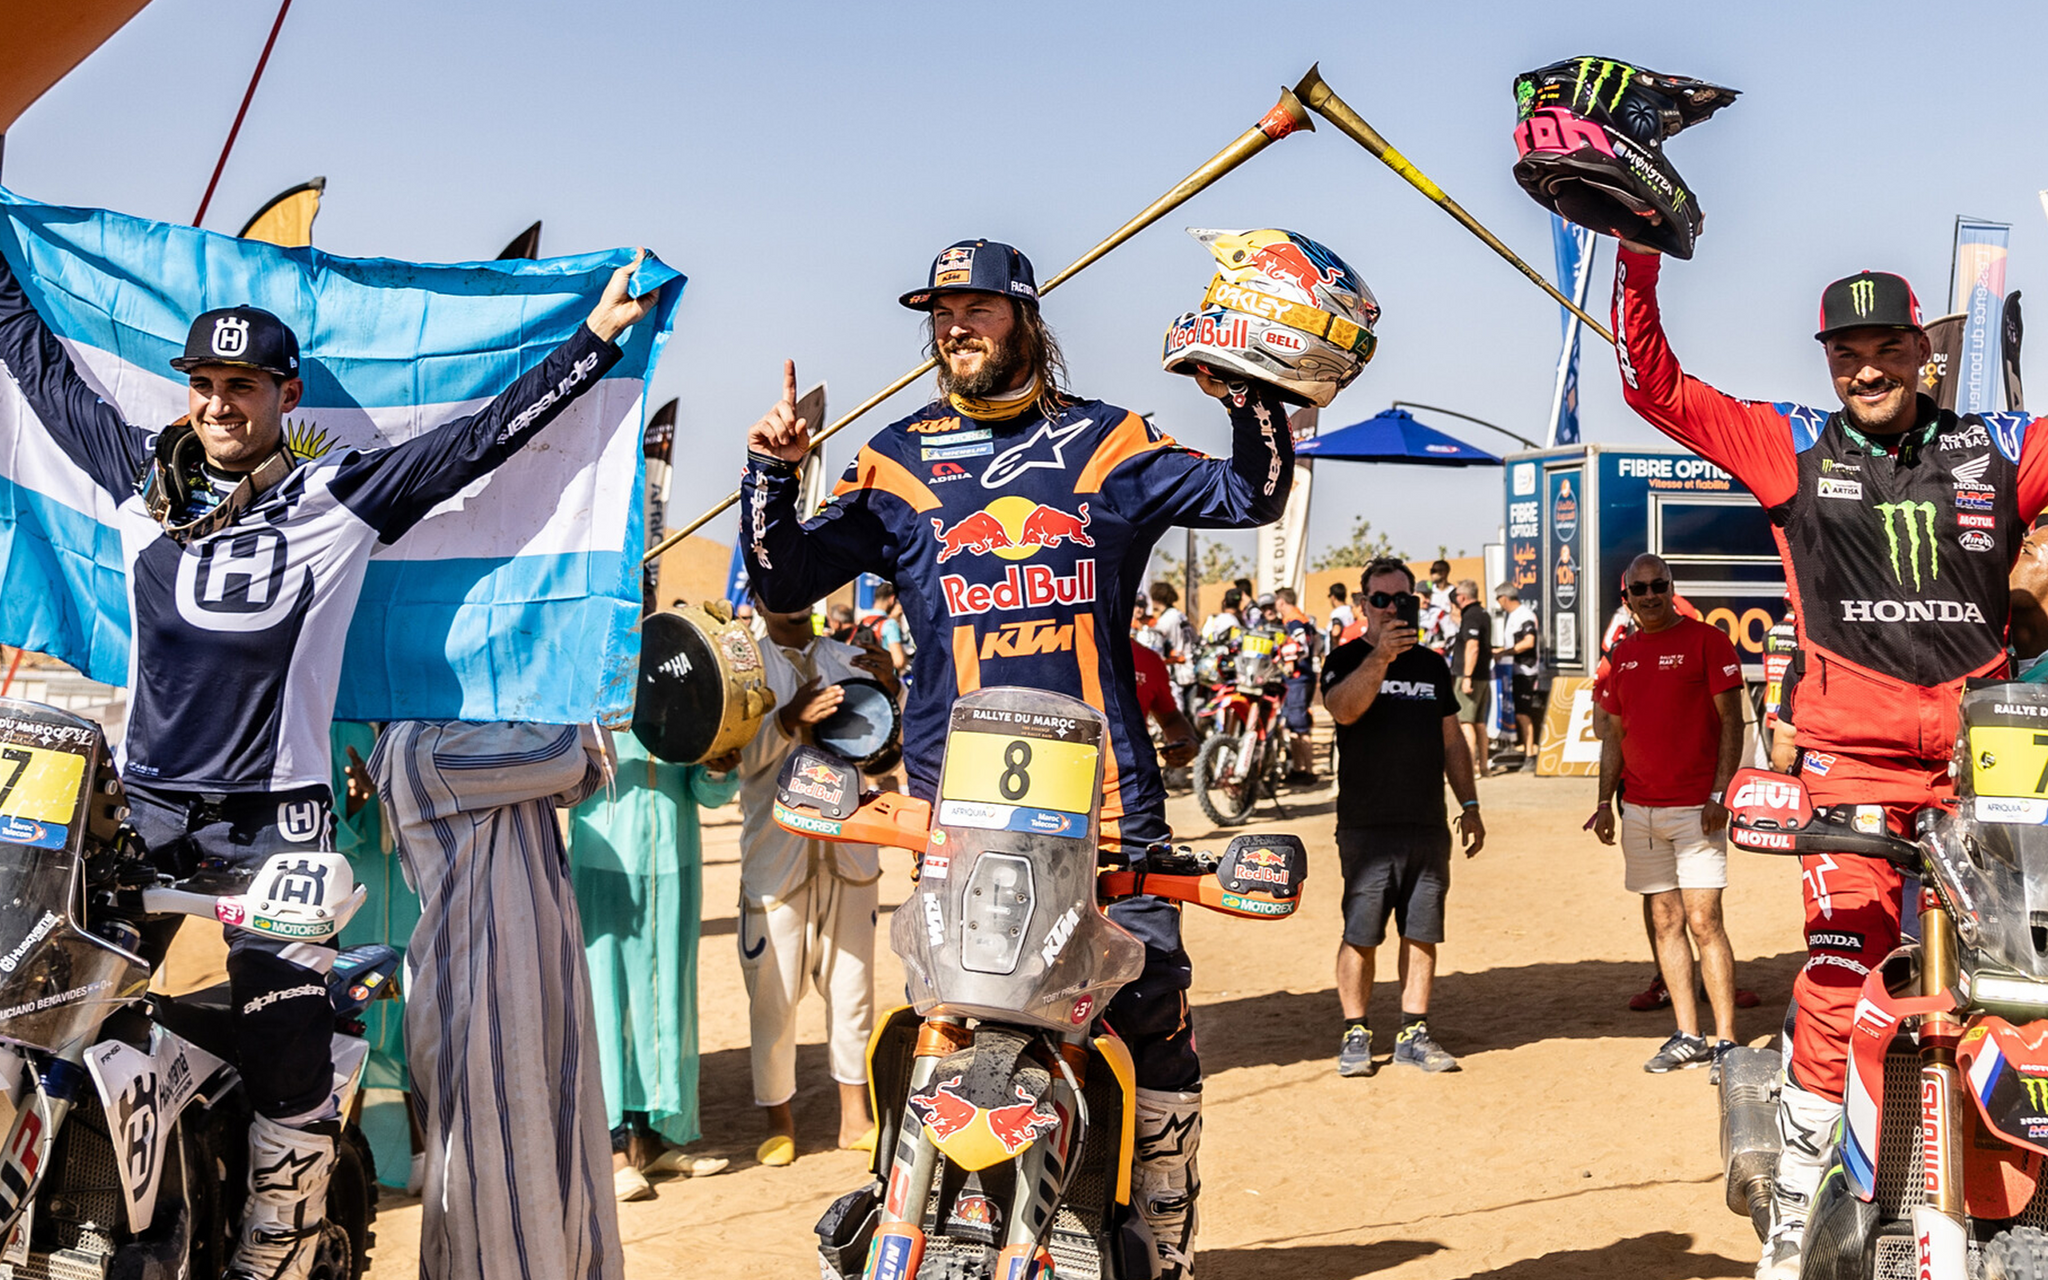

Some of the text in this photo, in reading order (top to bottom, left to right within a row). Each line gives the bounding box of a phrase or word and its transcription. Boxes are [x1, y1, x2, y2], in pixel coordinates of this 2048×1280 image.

[1215, 284, 1294, 320] OAKLEY
[1200, 318, 1249, 350] Bull
[1265, 332, 1302, 350] BELL
[906, 416, 961, 433] KTM
[1940, 435, 1990, 452] AIR BAG
[1619, 458, 1673, 478] FIBRE
[928, 472, 973, 485] ADRIA
[1648, 479, 1730, 490] Vitesse et fiabilité
[1953, 482, 1996, 492] HONDA
[1509, 501, 1539, 524] FIBRE
[1959, 514, 1994, 527] MOTUL
[941, 560, 1095, 615] Red Bull
[1840, 600, 1986, 624] HONDA
[980, 619, 1075, 660] KTM
[973, 709, 1076, 729] RALLYE DU MAROC
[1993, 704, 2038, 717] RALLYE
[16, 721, 60, 738] MAROC
[999, 740, 1032, 800] 8
[788, 777, 843, 805] Red Bull
[1732, 781, 1801, 810] GIVI
[951, 807, 987, 818] AFRIQUIA
[1987, 803, 2022, 812] AFRIQUIA
[10, 820, 34, 832] Maroc
[783, 813, 841, 835] MOTOREX
[1030, 819, 1059, 830] Telecom
[1037, 813, 1060, 823] Maroc
[1736, 830, 1790, 848] MOTUL
[1235, 864, 1290, 885] Red Bull
[1240, 899, 1293, 914] MOTOREX
[271, 921, 333, 936] MOTOREX
[923, 893, 945, 947] KTM
[1041, 907, 1080, 968] KTM
[1809, 933, 1862, 948] HONDA
[37, 985, 88, 1010] BENAVIDES
[243, 983, 326, 1015] alpinestars
